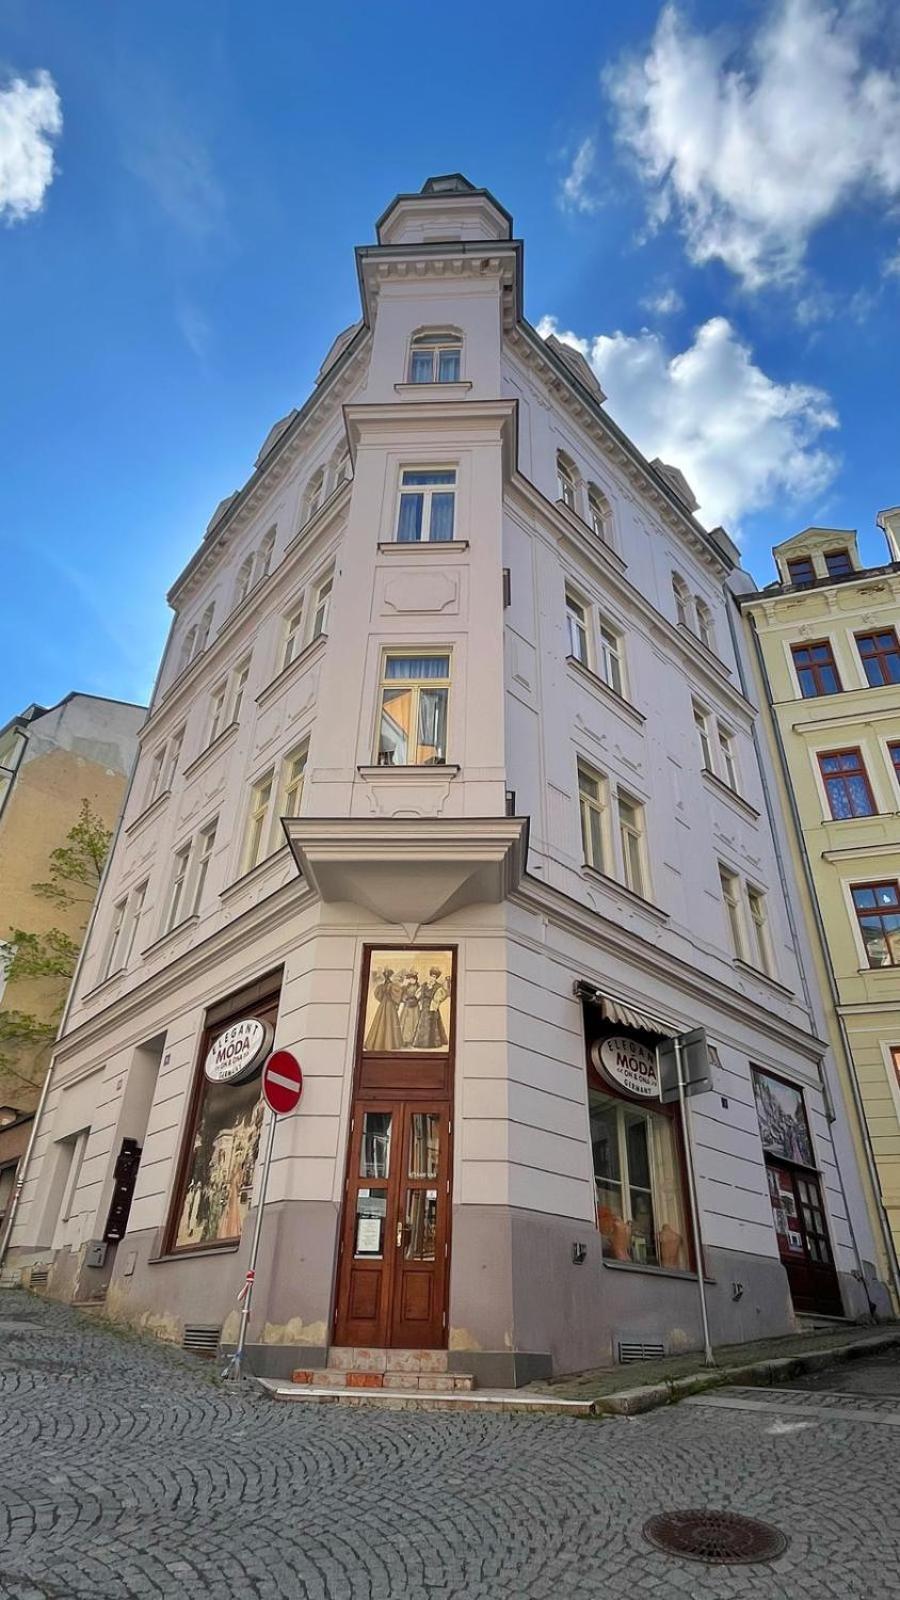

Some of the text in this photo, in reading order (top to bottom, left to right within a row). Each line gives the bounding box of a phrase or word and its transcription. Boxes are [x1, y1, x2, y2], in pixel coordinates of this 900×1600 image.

[212, 1023, 258, 1055] ELEGANT
[216, 1036, 251, 1064] MODA
[607, 1040, 654, 1064] ELEGAN
[616, 1053, 657, 1080] MODA
